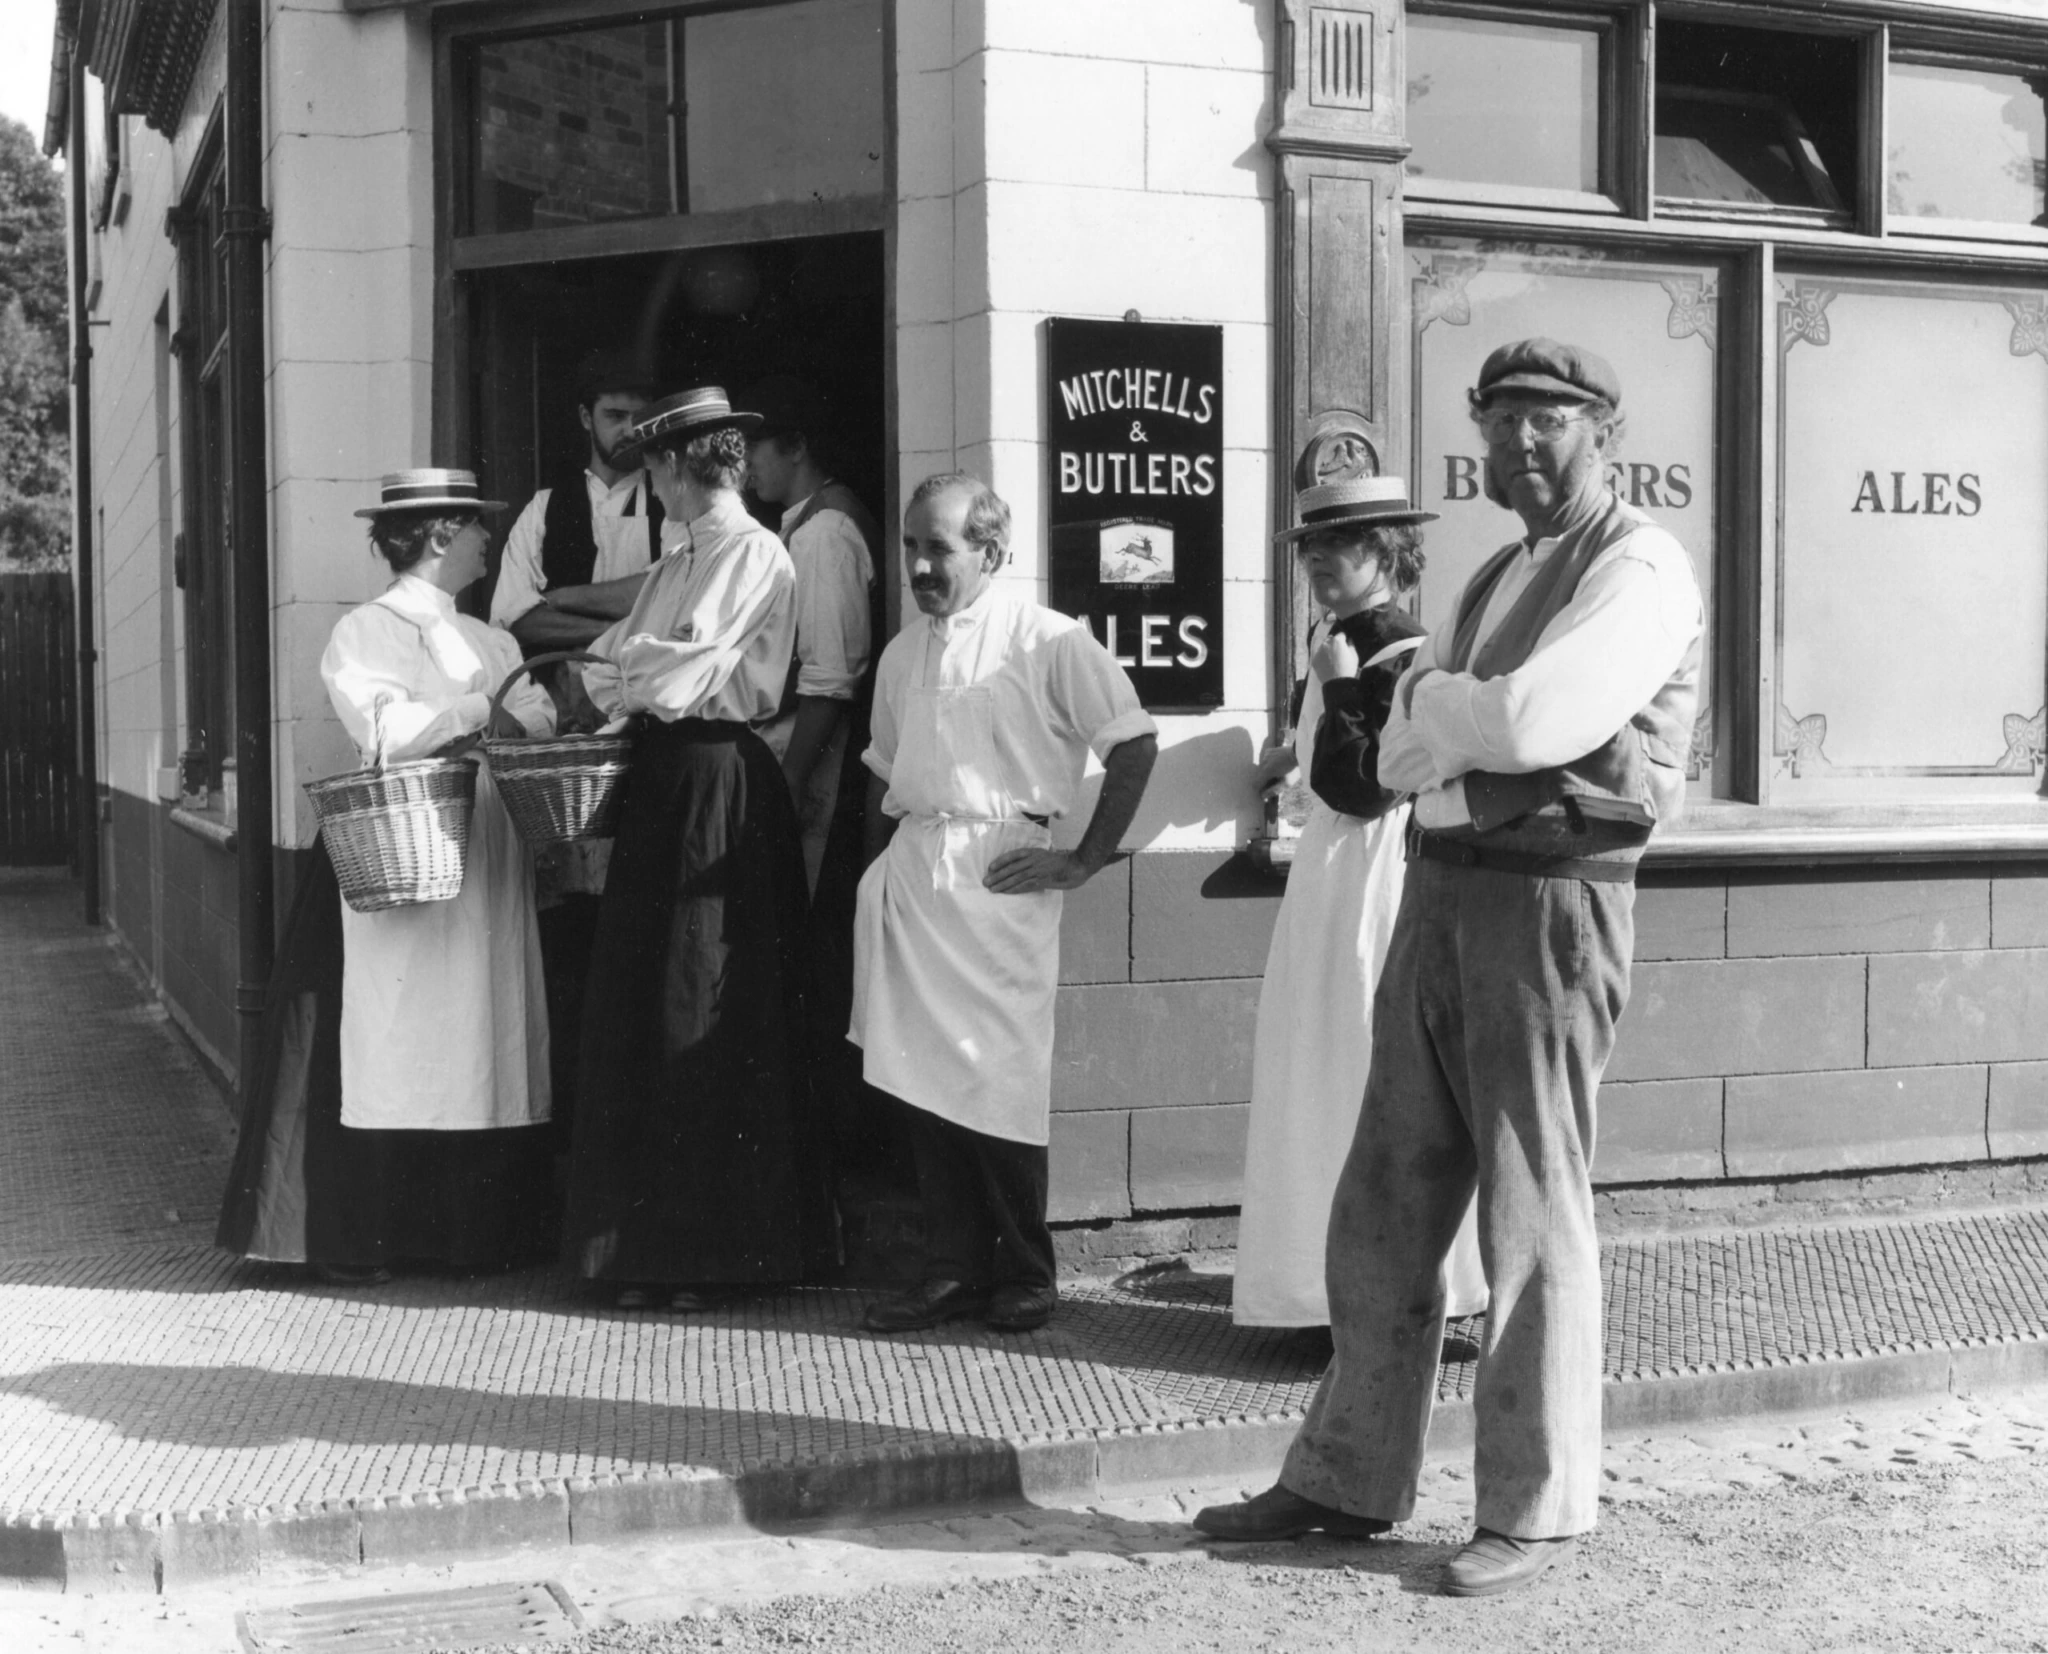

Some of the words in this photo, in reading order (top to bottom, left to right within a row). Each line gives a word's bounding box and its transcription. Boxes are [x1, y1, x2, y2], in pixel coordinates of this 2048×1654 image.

[1059, 367, 1216, 423] MITCHELLS
[1129, 420, 1148, 442] &
[1060, 451, 1215, 495] BUTLERS
[1443, 455, 1692, 509] BERS
[1851, 470, 1981, 516] ALES
